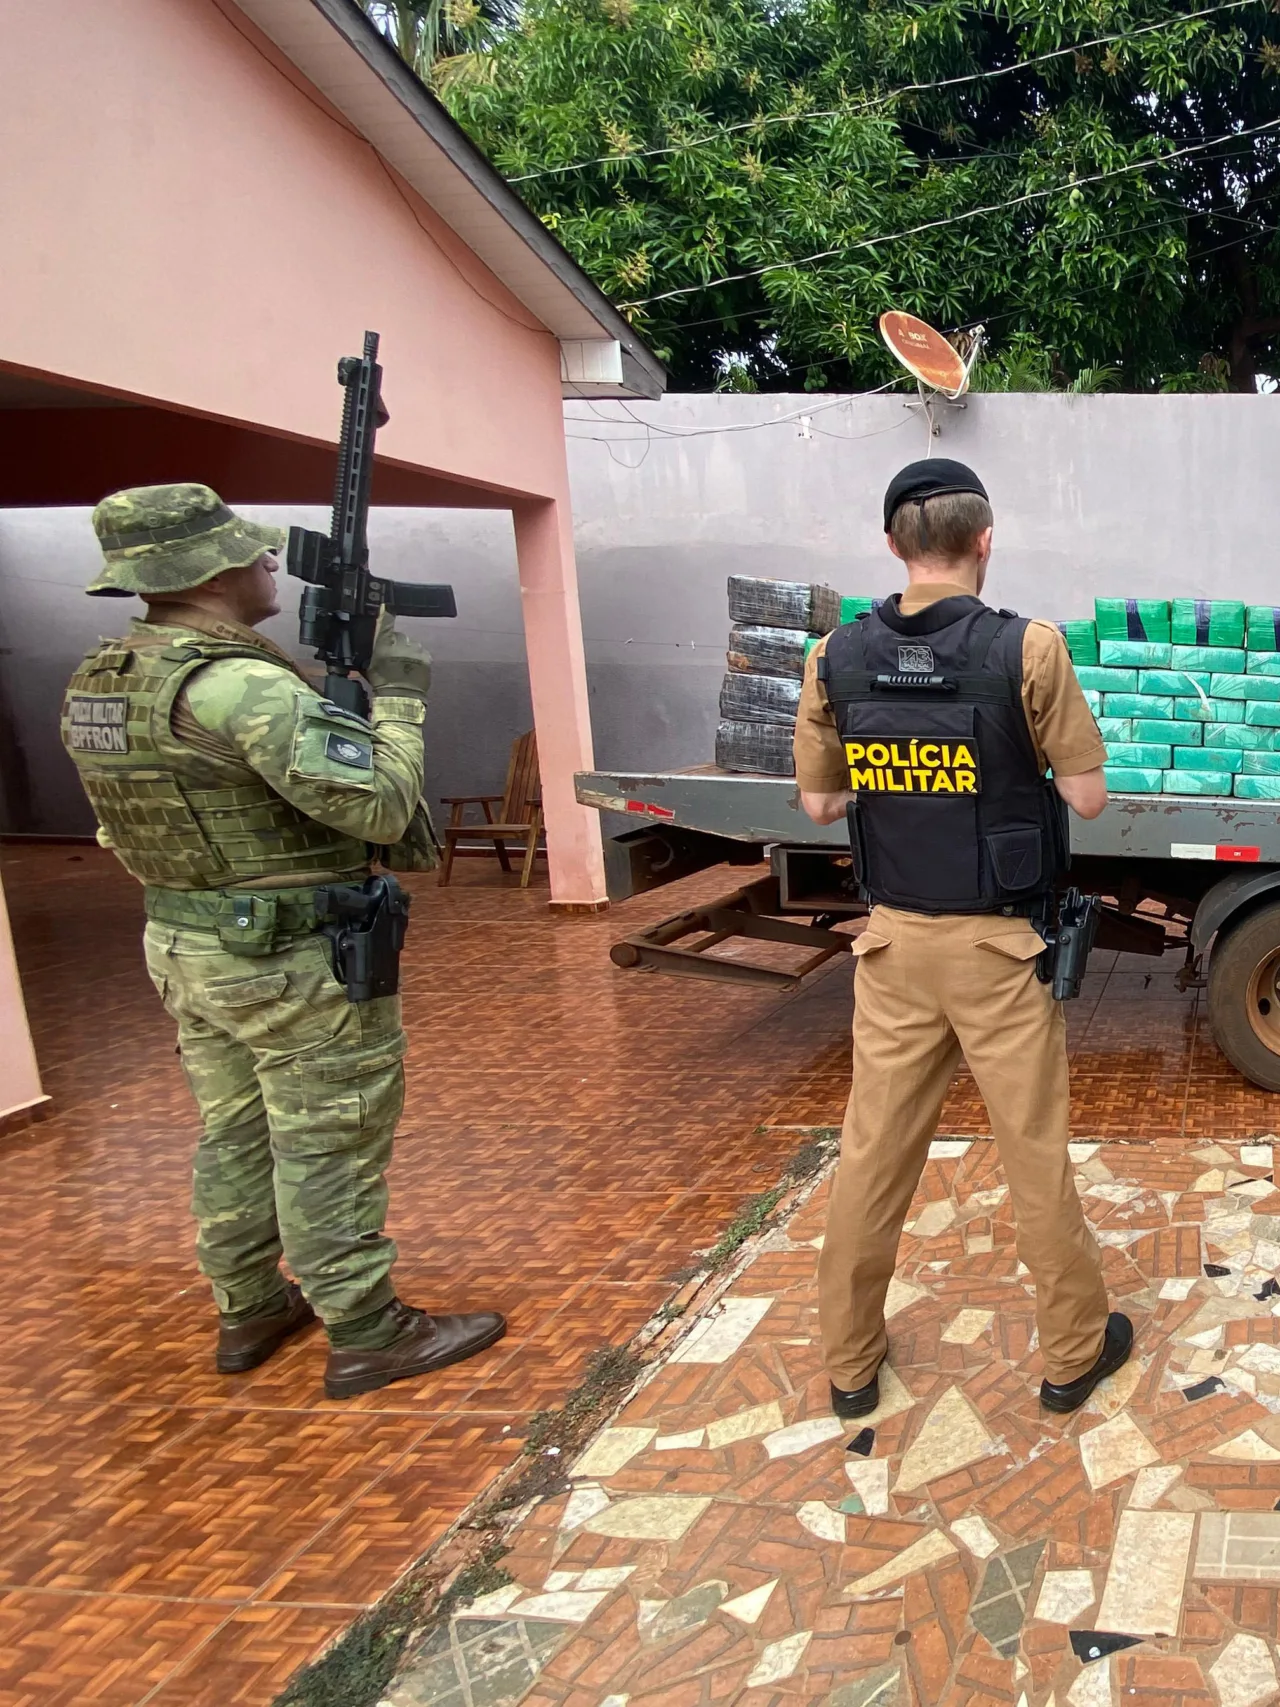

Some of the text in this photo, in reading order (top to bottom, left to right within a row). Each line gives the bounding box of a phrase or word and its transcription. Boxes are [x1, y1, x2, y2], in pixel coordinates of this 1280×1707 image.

[71, 725, 125, 751] BPFRON
[844, 738, 976, 768] POLÍCIA
[849, 767, 978, 793] MILITAR
